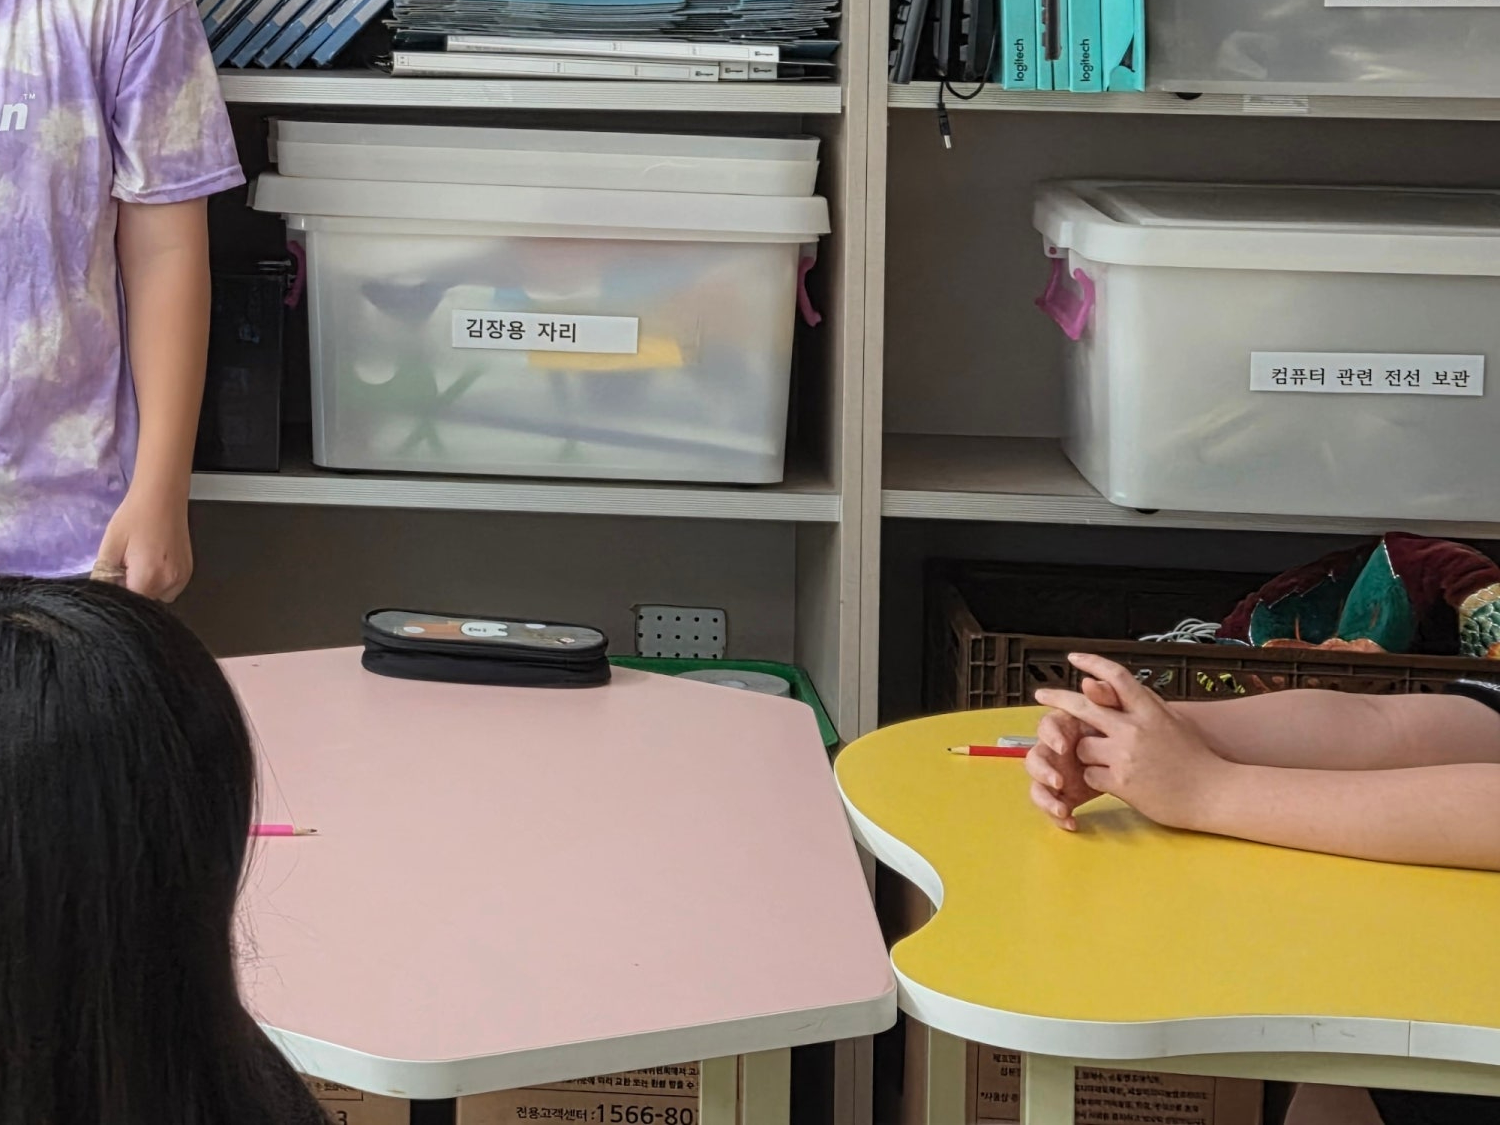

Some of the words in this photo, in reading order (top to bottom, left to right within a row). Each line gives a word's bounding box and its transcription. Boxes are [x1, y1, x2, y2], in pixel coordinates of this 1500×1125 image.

[1014, 38, 1028, 82] logitech
[1080, 38, 1093, 82] logitech
[466, 318, 526, 340] 김장용
[538, 322, 577, 343] 자리
[1272, 367, 1325, 386] 컴퓨터
[1336, 368, 1373, 386] 관련
[1384, 369, 1420, 387] 전선
[1432, 369, 1470, 388] 보관
[516, 1106, 588, 1122] 전용고객센터
